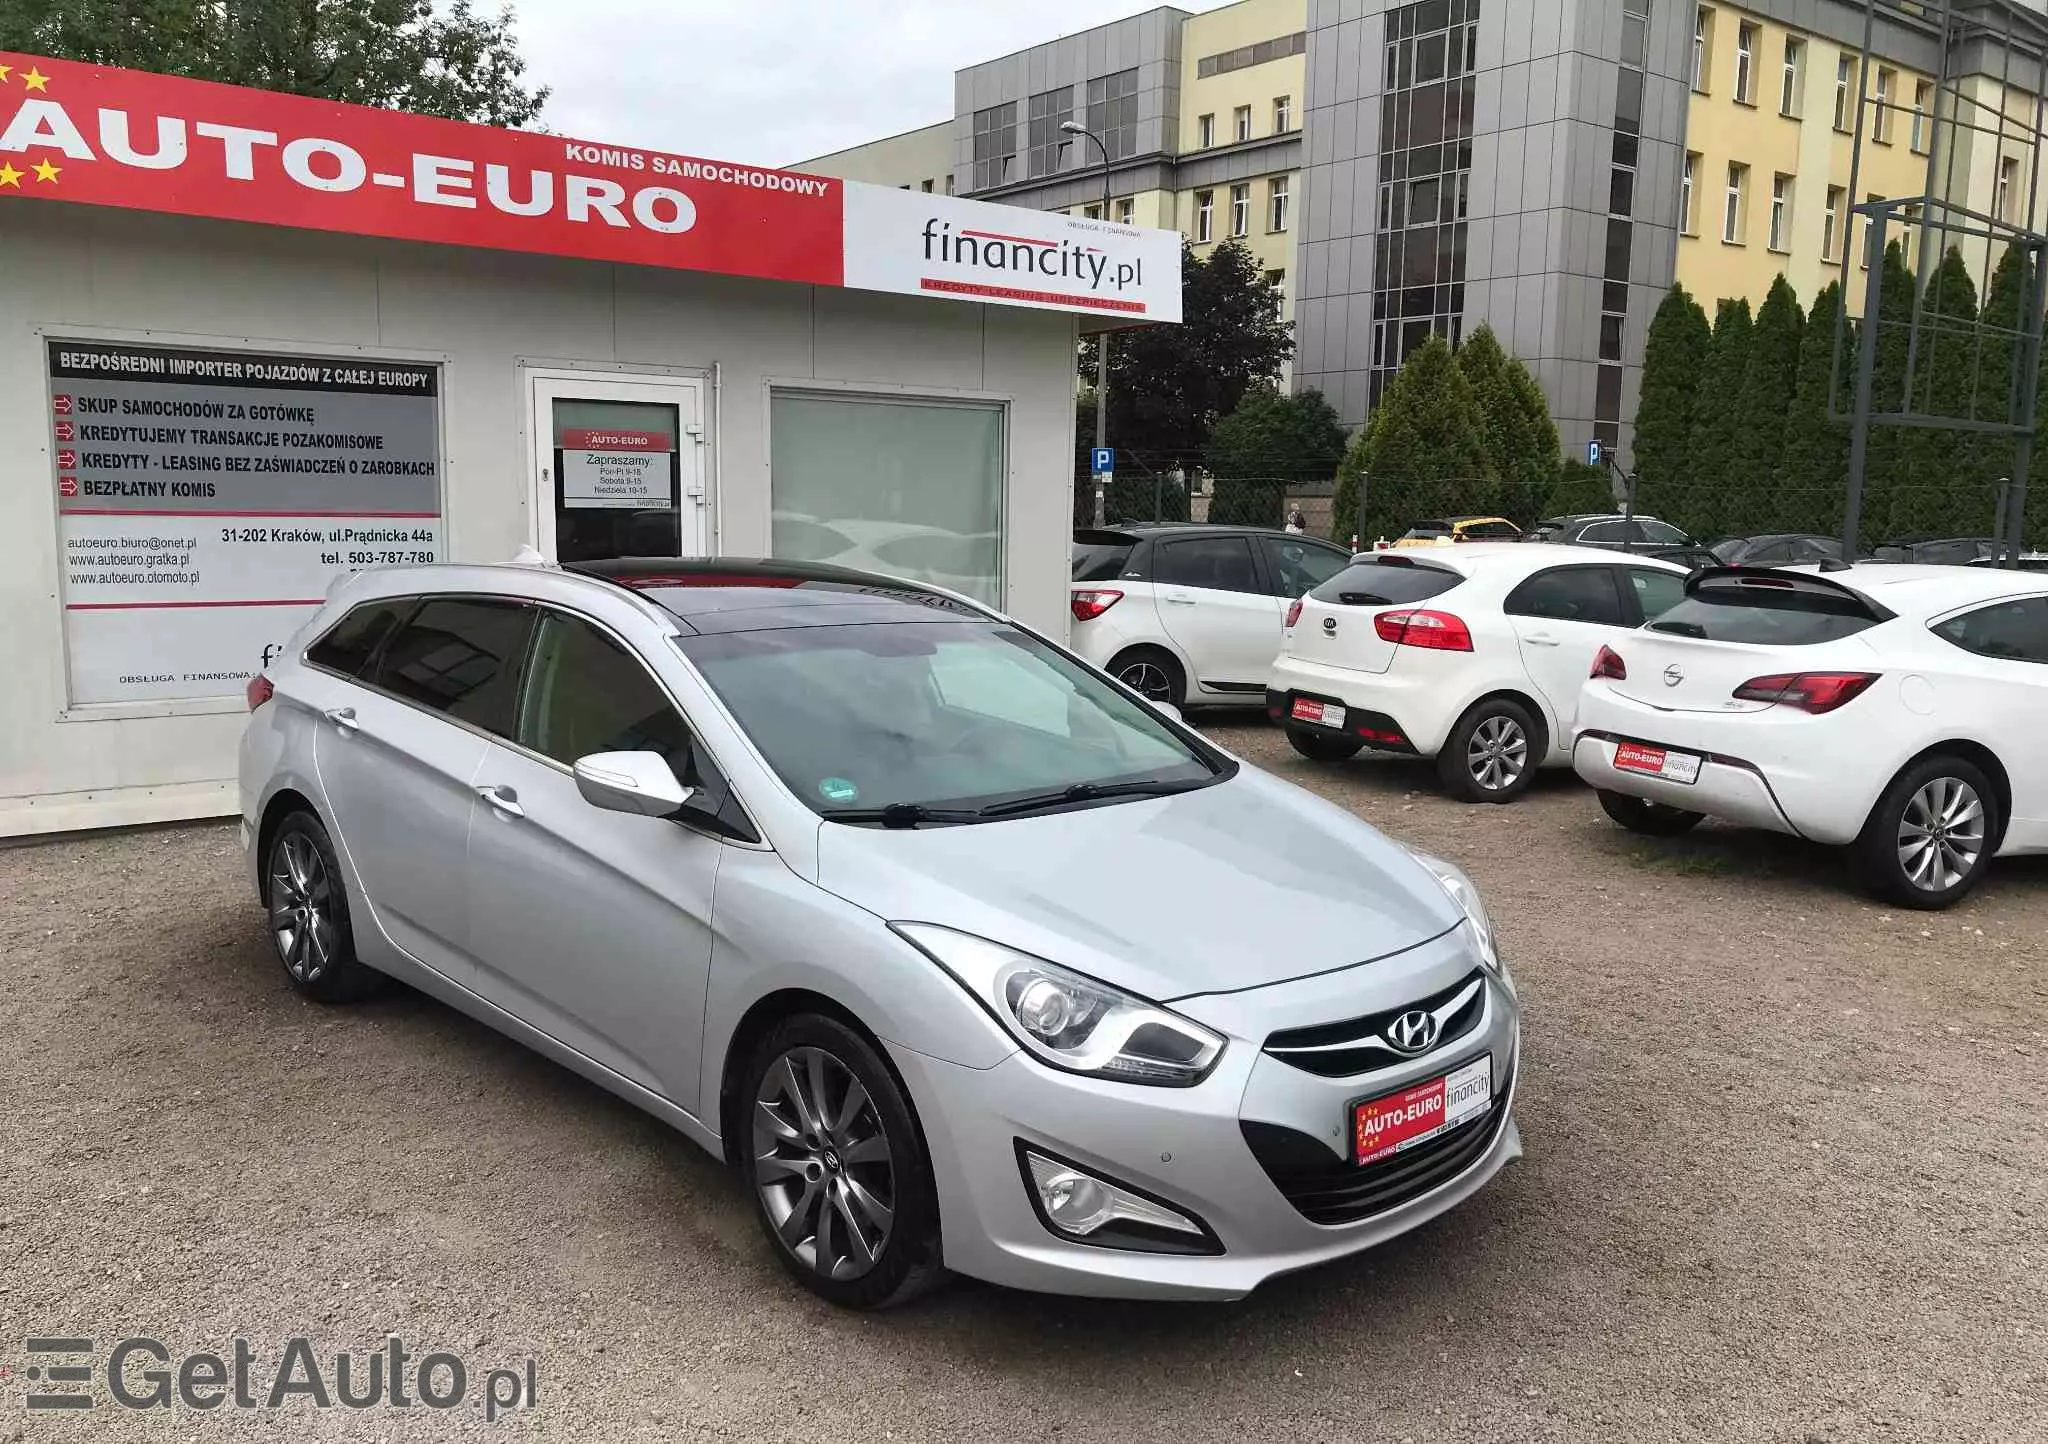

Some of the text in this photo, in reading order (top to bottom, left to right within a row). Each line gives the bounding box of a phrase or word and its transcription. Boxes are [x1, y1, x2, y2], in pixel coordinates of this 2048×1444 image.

[0, 98, 697, 233] AUTO-EURO
[566, 143, 829, 197] KOMIS SAMOCHODOWY
[921, 218, 1142, 290] financity.pl
[60, 351, 428, 388] BEZPOŚREDNI IMPORTER POJAZDÓW Z CAŁEJ EUROPY
[78, 397, 314, 426] SKUP SAMOCHODÓW ZA GOTÓWKĘ
[80, 425, 383, 450] KREDYTUJEMY TRANSAKCJE POZAKOMISOWE
[591, 434, 648, 445] AUTO-EURO
[1097, 450, 1109, 469] P
[1590, 443, 1598, 465] P
[82, 453, 149, 469] KREDYTY
[162, 456, 221, 471] LEASING
[225, 458, 250, 473] BEZ
[254, 456, 345, 474] ZAŚWIADCZEŃ
[349, 460, 358, 474] O
[361, 460, 435, 476] ZAROBKACH
[84, 480, 216, 497] BEZPŁATNY KOMIS
[600, 477, 624, 485] Sobota
[594, 486, 626, 494] Niedziela
[68, 537, 197, 550] autoeuro.biuro@onet.pl
[221, 528, 433, 545] 31-202 Kraków, ul.Prądnicka 44a
[69, 553, 189, 568] www.autoeuro.gratka.pl
[321, 552, 434, 564] tel. 503-787-780
[70, 571, 200, 585] www.autoeuro.otomoto.pl
[119, 674, 175, 683] OBSŁUGA
[1621, 750, 1662, 765] AUTO-EURO
[1364, 1094, 1442, 1137] AUTO-EURO
[1447, 1072, 1490, 1108] financity
